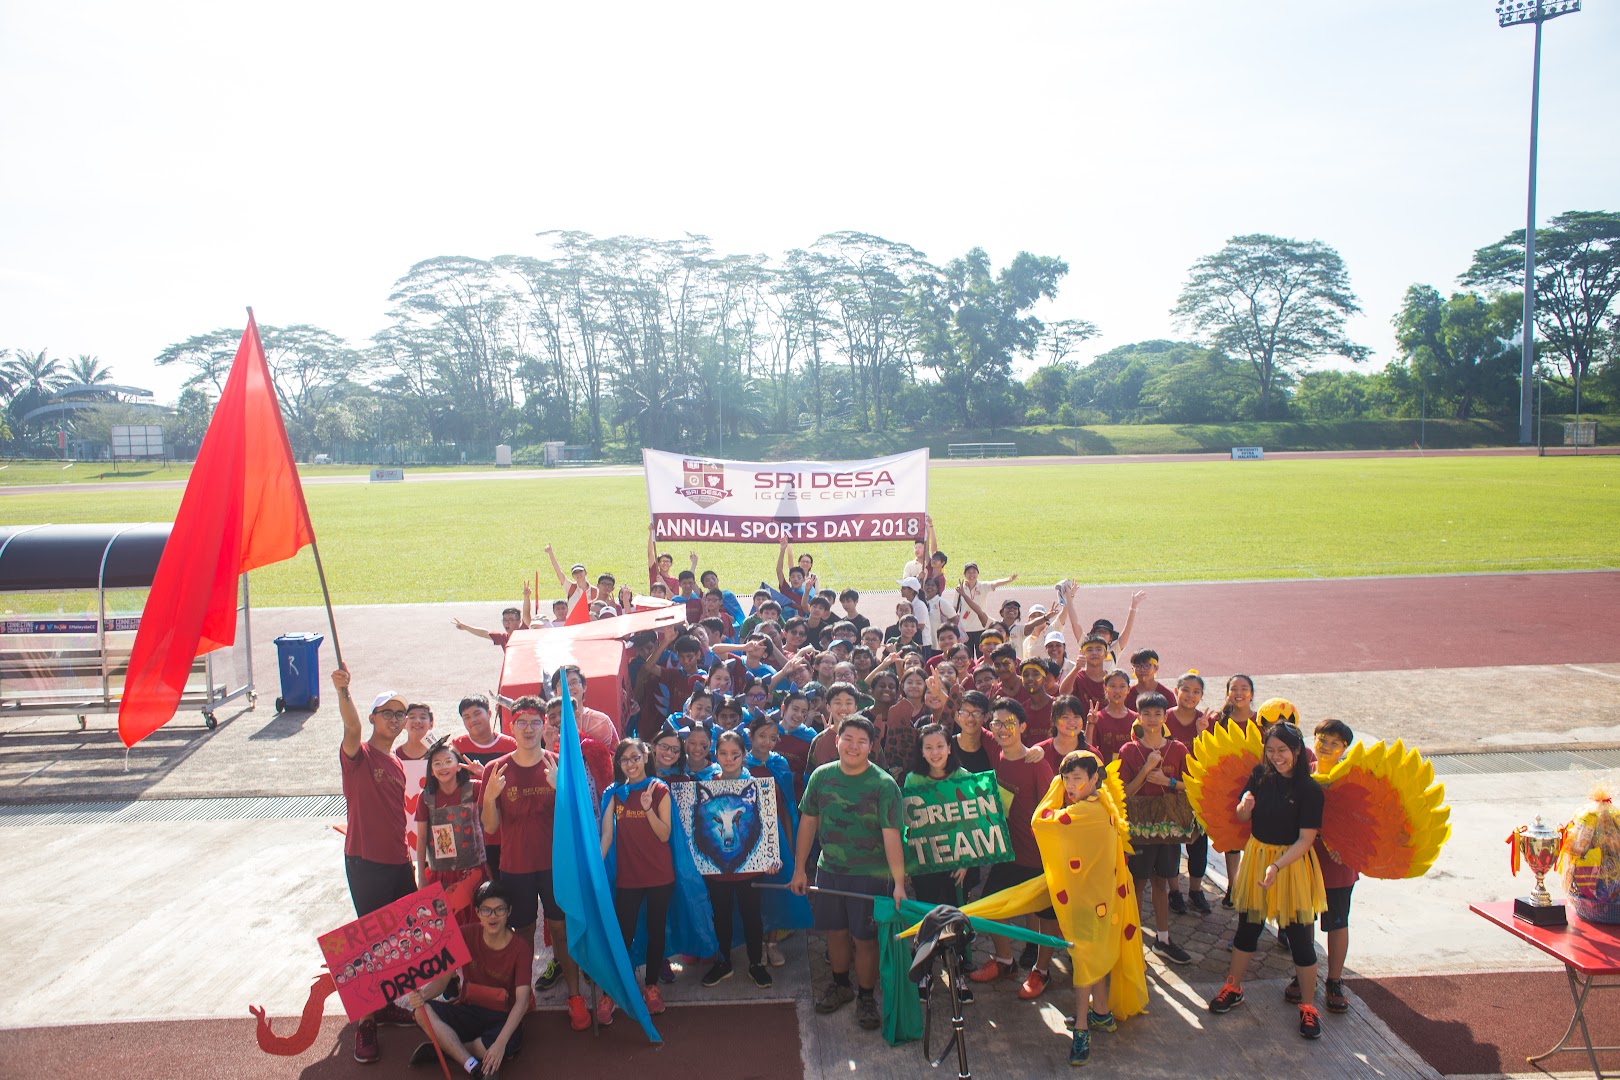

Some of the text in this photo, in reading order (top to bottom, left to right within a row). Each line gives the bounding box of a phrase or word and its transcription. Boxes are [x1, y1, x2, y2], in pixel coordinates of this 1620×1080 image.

[754, 470, 895, 489] SRI DESA
[701, 489, 722, 498] DESA
[755, 488, 896, 501] IGCSE CENTRE
[656, 518, 919, 539] ANNUAL SPORTS DAY 2018
[902, 794, 998, 829] GREEN
[762, 789, 775, 859] WOLVES
[907, 824, 1007, 865] TEAM
